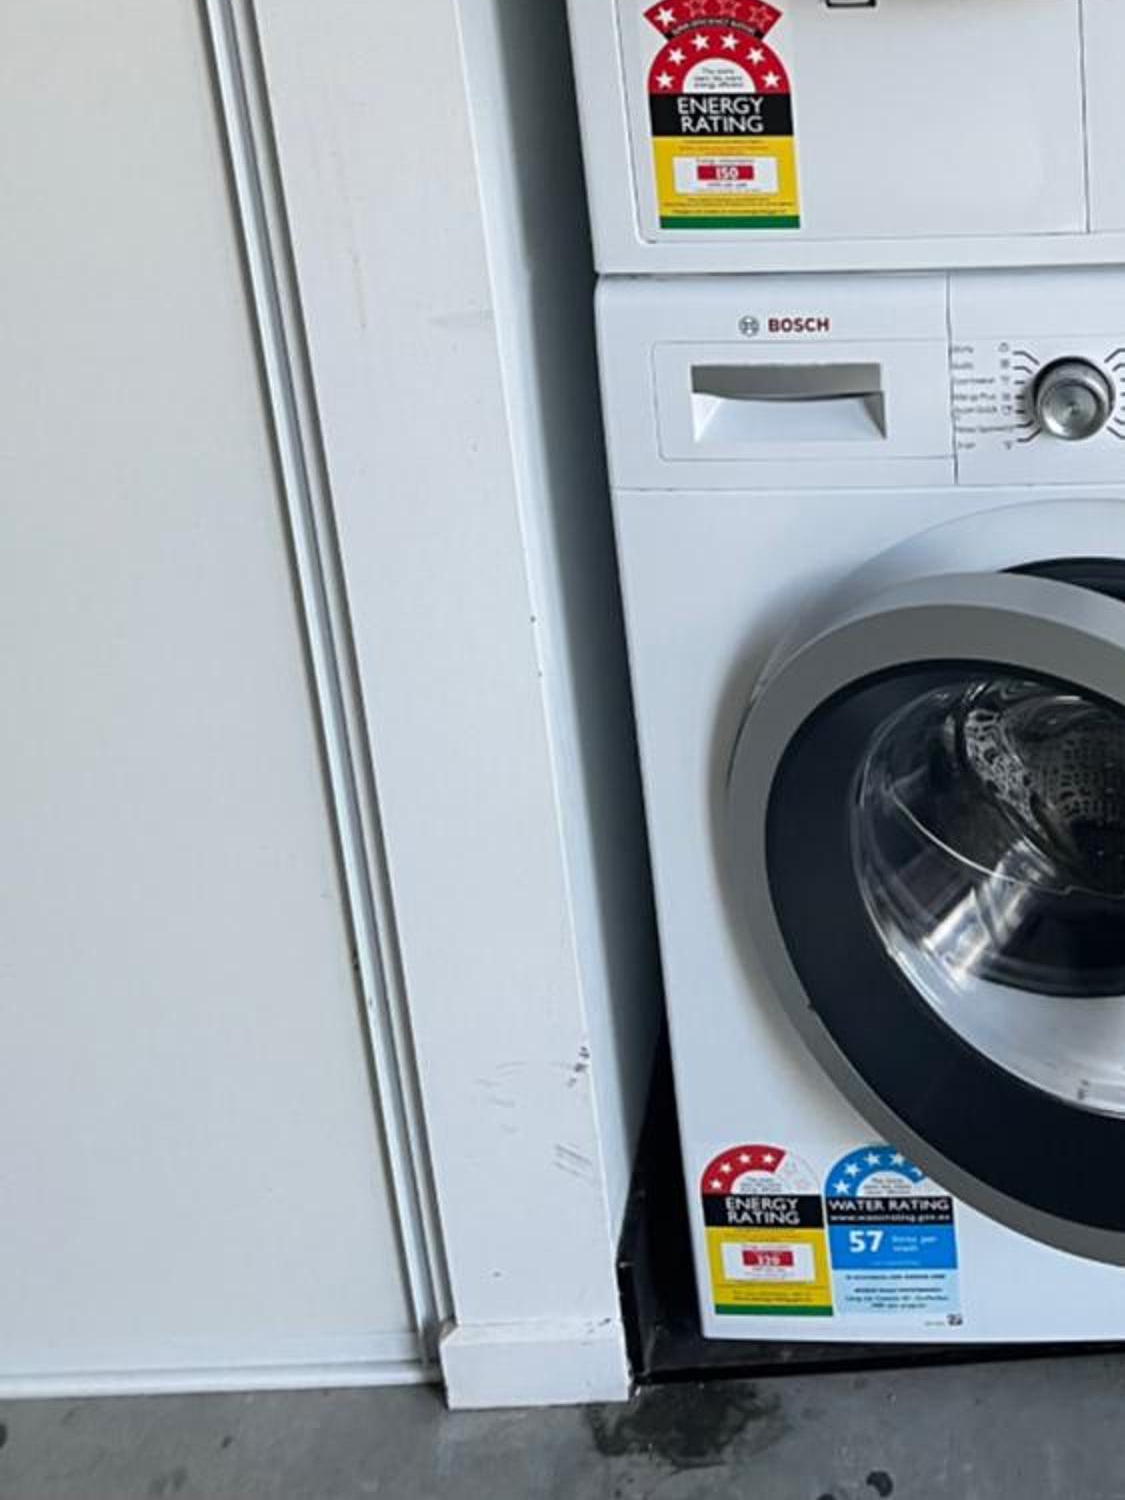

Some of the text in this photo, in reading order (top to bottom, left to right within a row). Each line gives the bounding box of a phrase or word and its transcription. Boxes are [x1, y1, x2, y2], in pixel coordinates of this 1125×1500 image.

[677, 97, 764, 115] ENERGY
[681, 115, 764, 133] RATING
[768, 317, 830, 333] BOSCH
[725, 1198, 799, 1211] ENERGY
[829, 1198, 949, 1212] WATER RATING
[727, 1211, 800, 1225] RATING
[849, 1230, 883, 1253] 57
